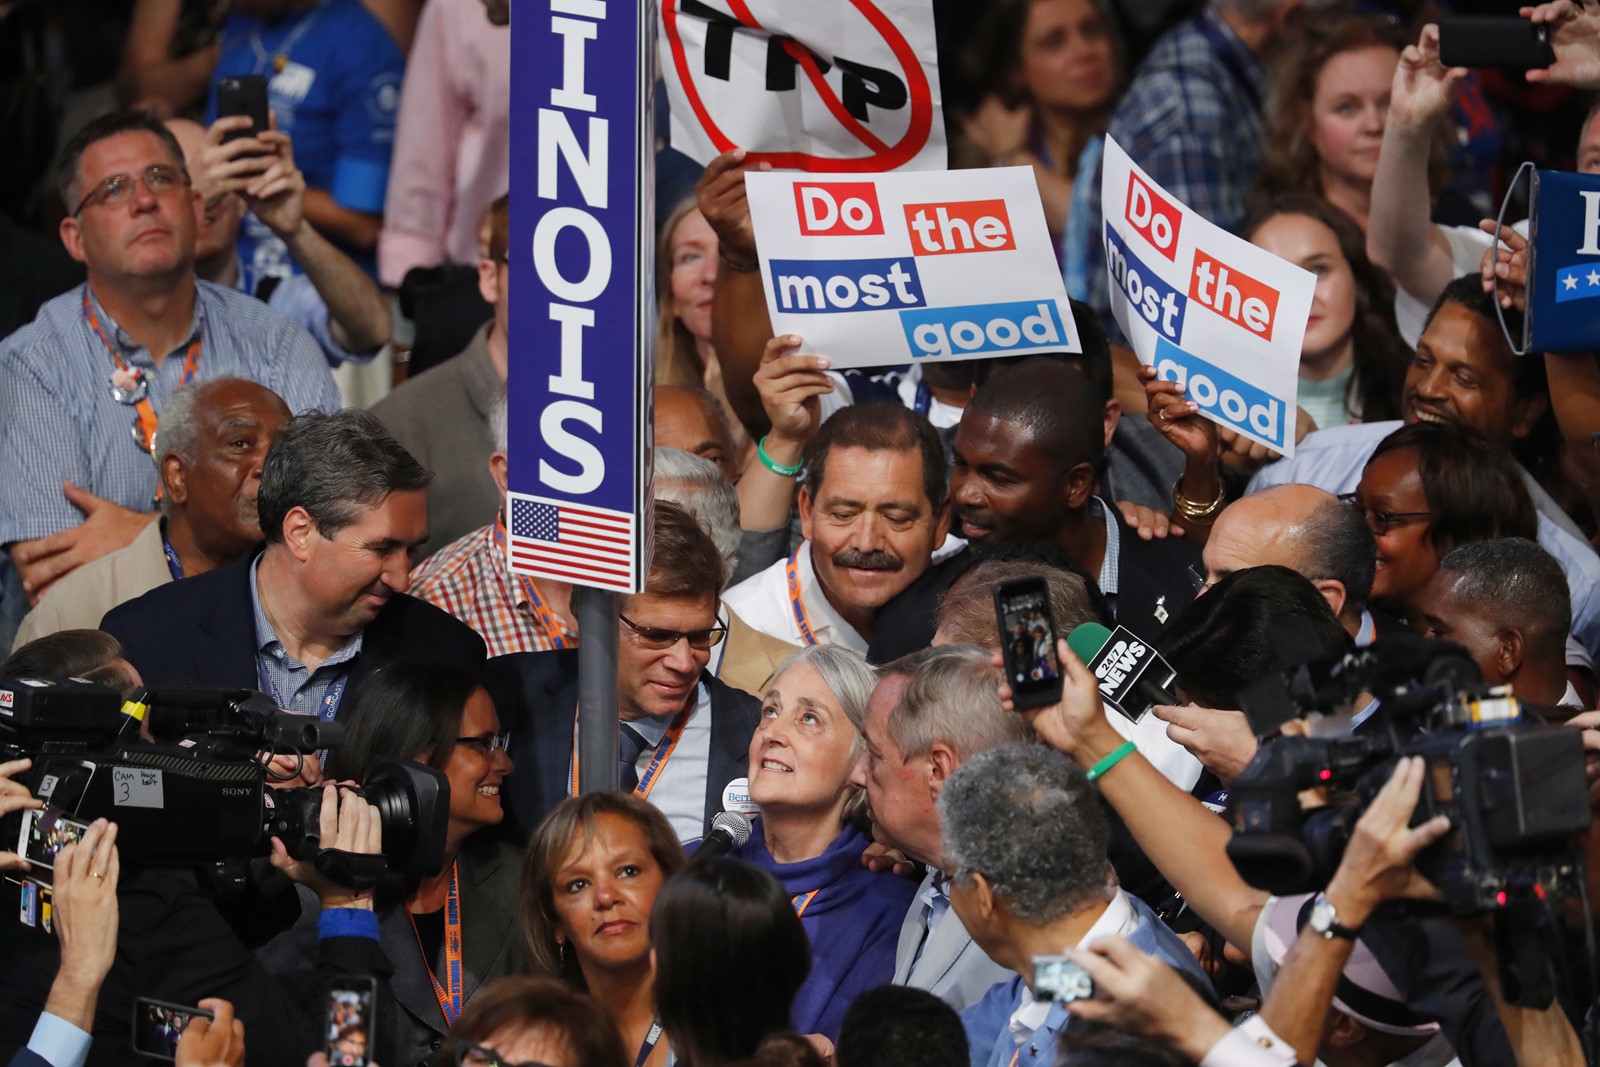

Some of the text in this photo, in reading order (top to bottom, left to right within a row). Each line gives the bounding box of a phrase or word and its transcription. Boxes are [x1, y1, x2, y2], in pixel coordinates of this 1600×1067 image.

[801, 187, 1008, 252] Do the
[533, 0, 612, 494] INOIS
[1128, 178, 1273, 334] Do the
[776, 261, 918, 309] most
[1107, 237, 1180, 332] most
[912, 305, 1061, 357] good
[1157, 357, 1279, 443] good
[1098, 641, 1146, 696] NEWS
[1101, 648, 1120, 671] 24/7
[326, 683, 343, 718] COMCAST
[119, 782, 129, 803] 3
[222, 787, 252, 796] SONY
[637, 761, 660, 793] STRONG
[728, 792, 753, 802] Bern
